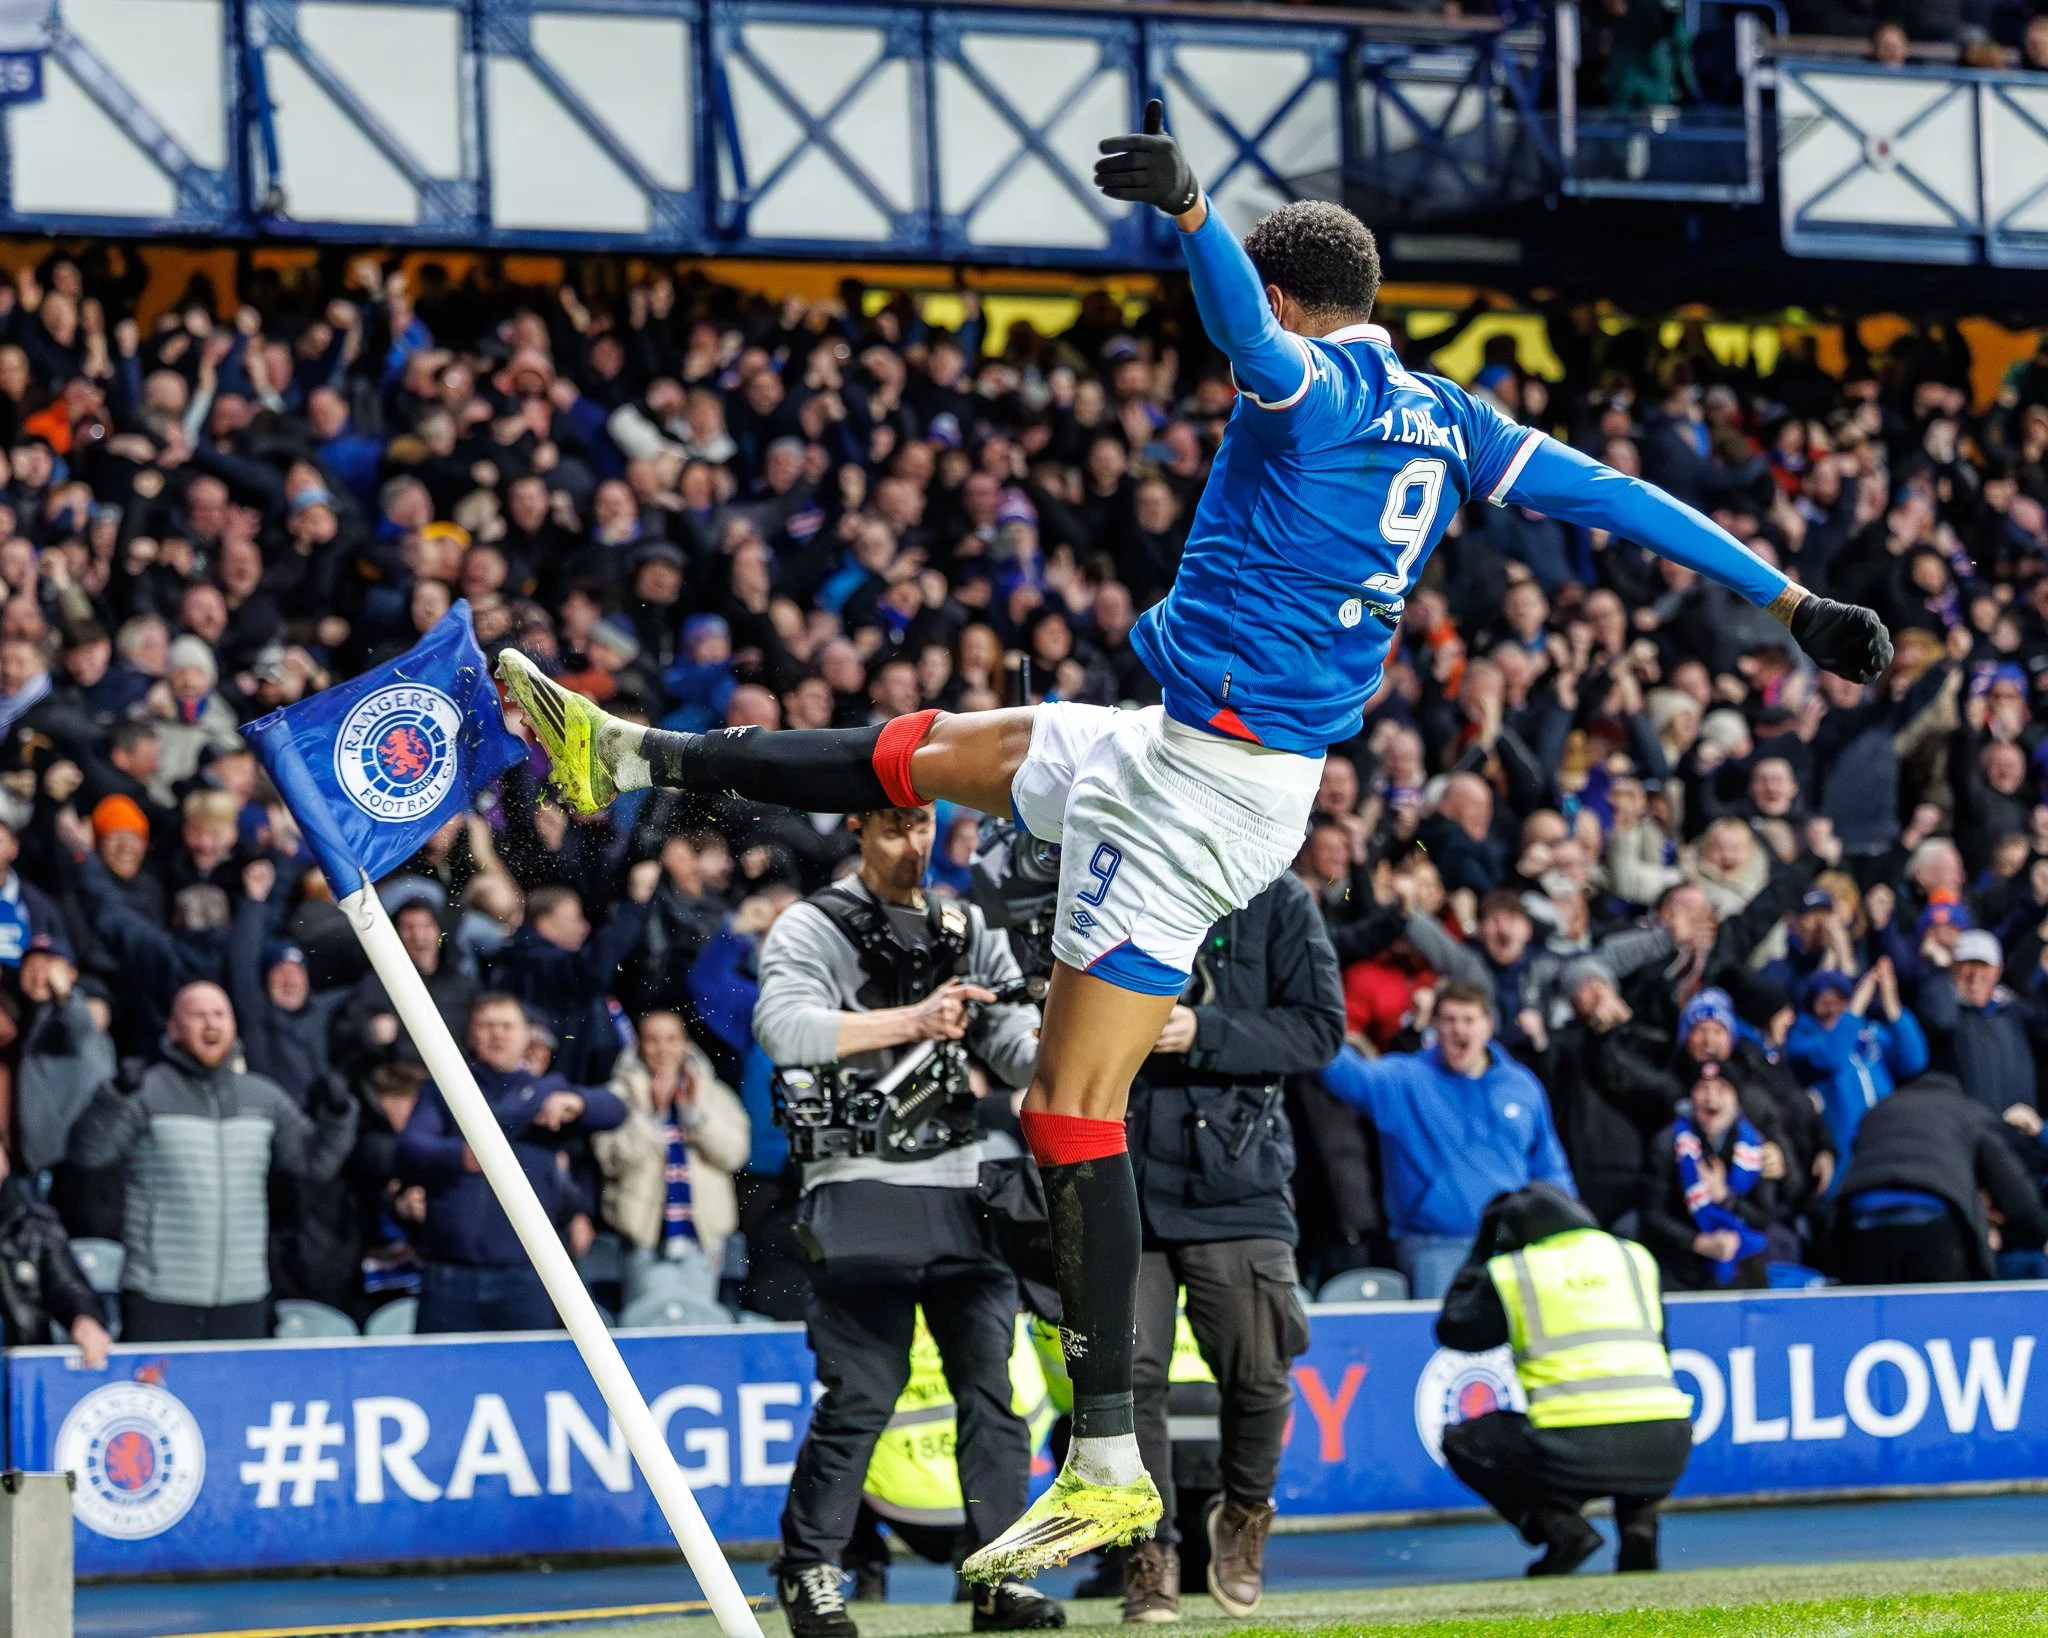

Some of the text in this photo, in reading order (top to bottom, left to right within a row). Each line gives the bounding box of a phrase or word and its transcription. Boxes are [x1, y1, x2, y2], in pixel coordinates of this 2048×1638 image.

[1361, 457, 1447, 595] 9
[344, 692, 438, 752] RANGERS
[360, 784, 442, 813] FOOTBALL
[404, 772, 435, 796] READY
[1077, 842, 1122, 907] 9
[1069, 924, 1091, 939] umbro
[240, 1382, 826, 1508] #RANGE
